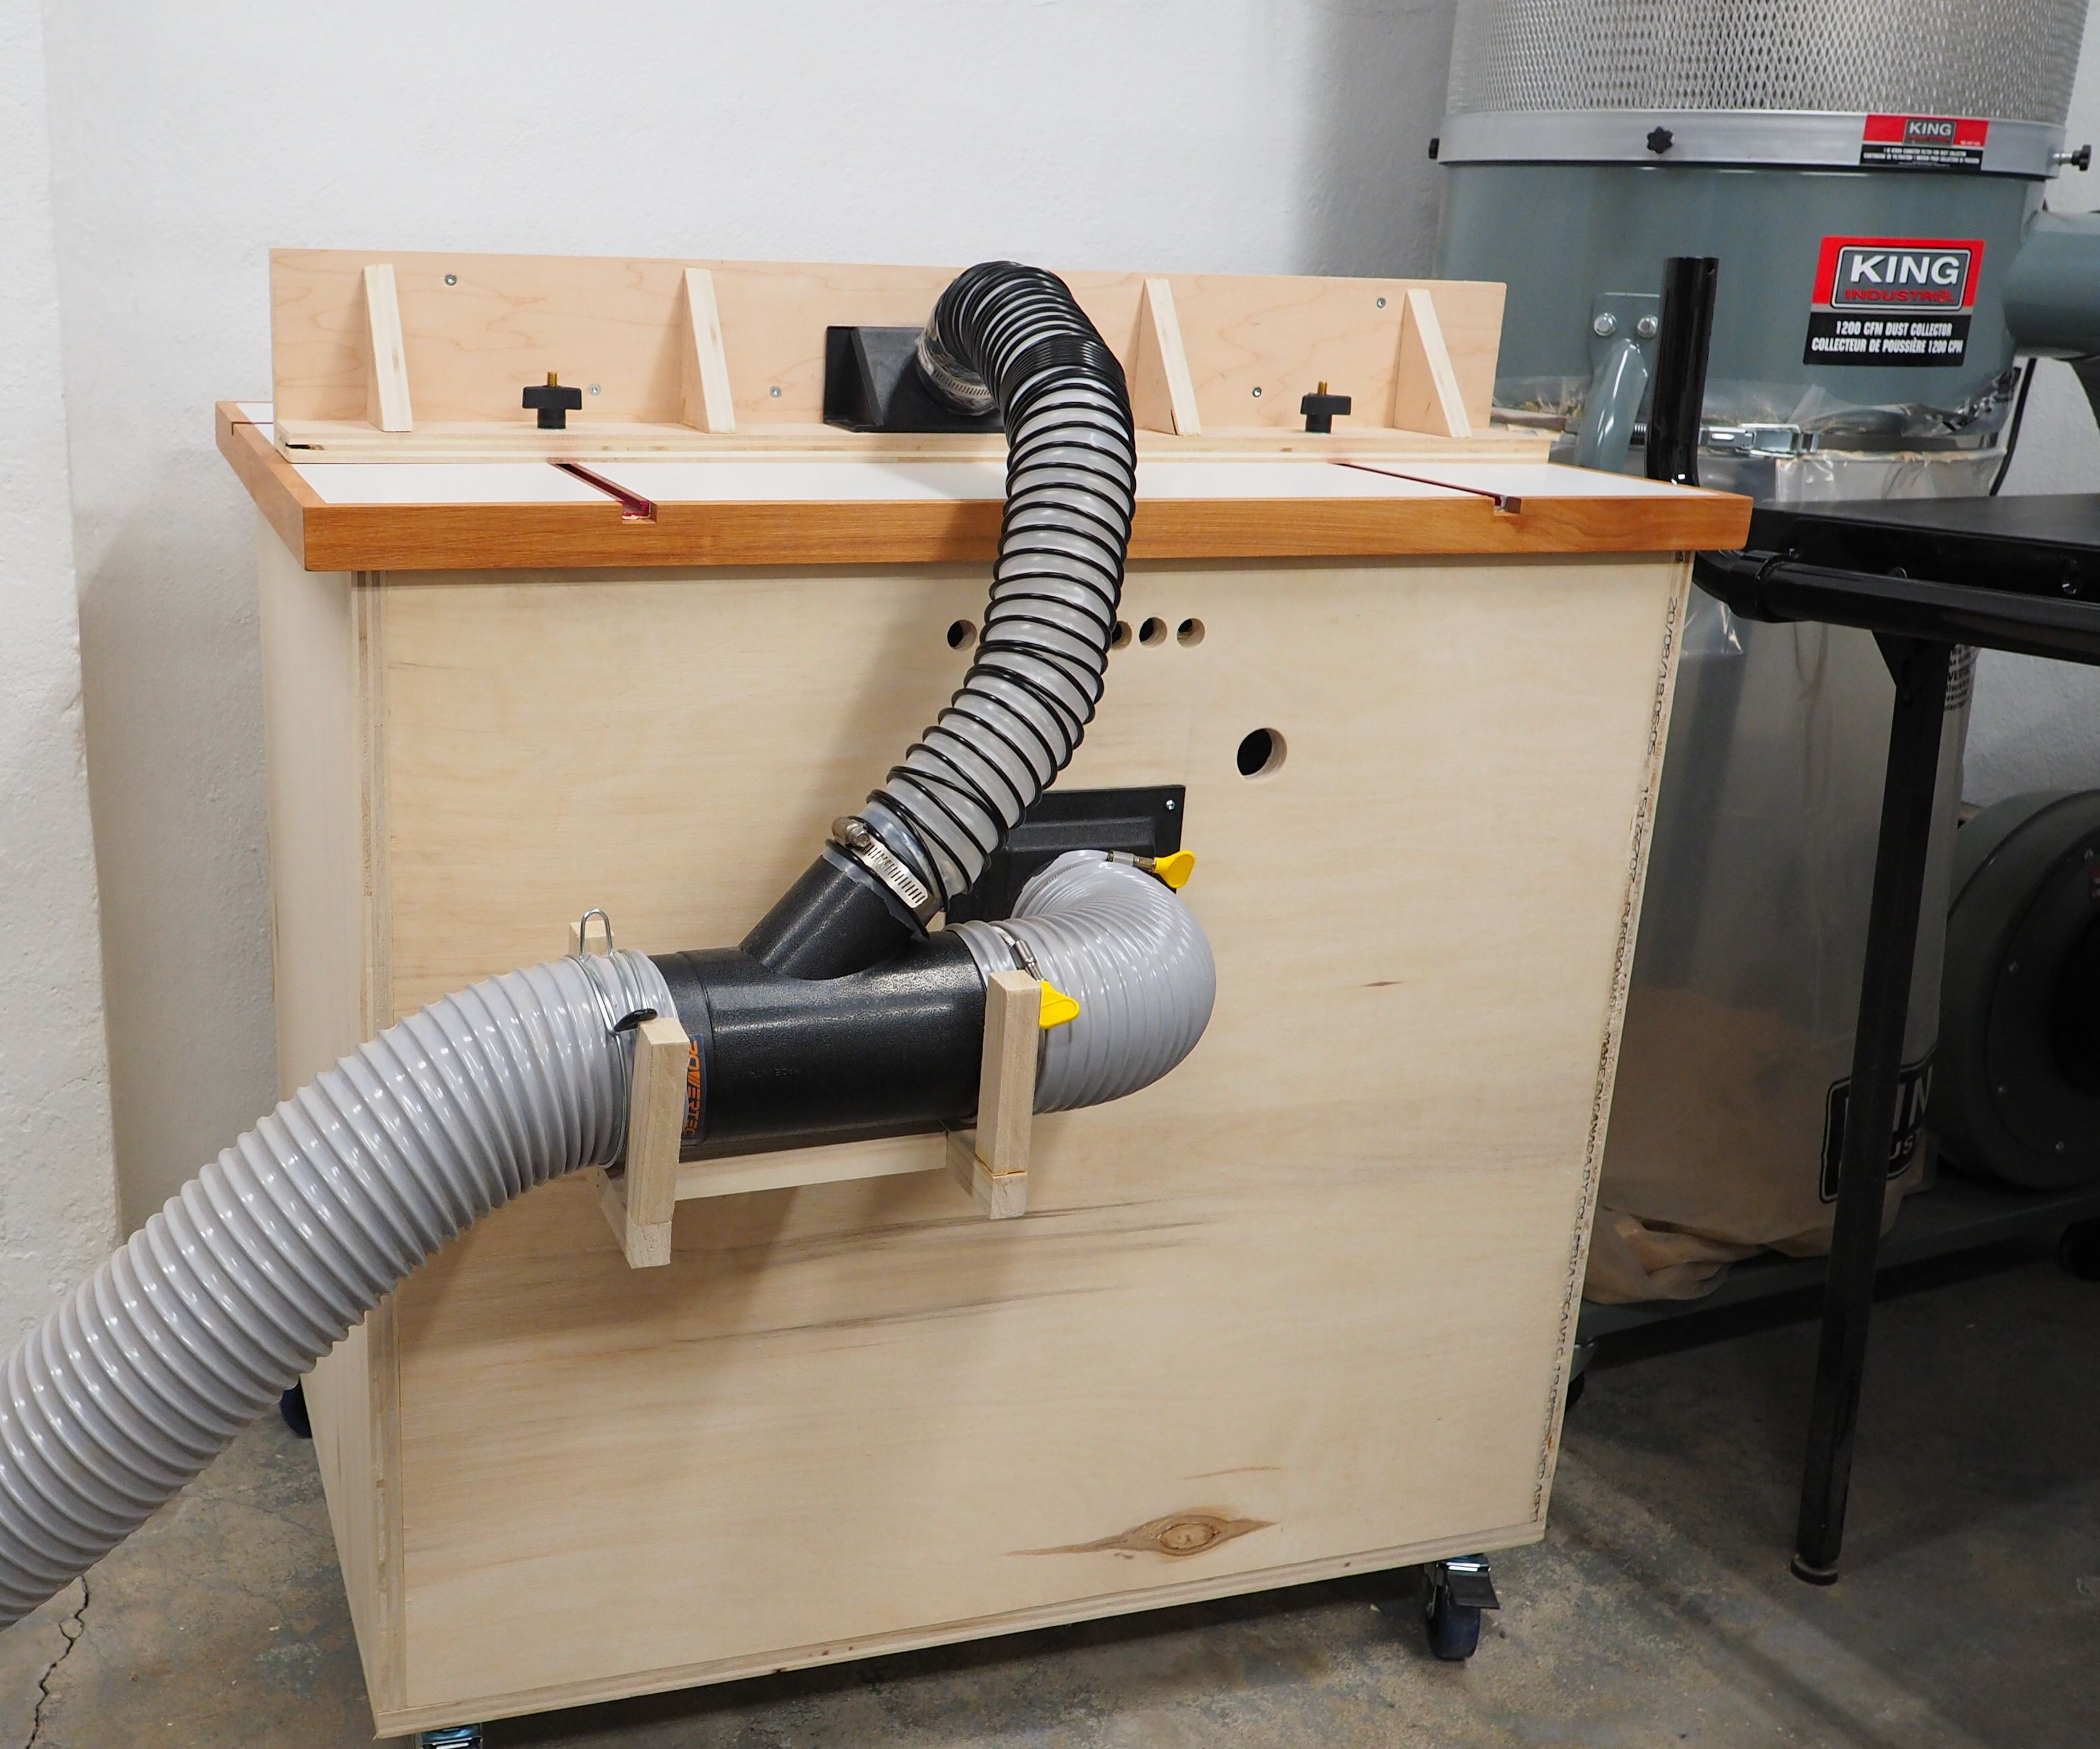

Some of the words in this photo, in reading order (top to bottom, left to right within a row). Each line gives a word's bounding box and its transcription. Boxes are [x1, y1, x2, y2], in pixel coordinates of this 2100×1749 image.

[1909, 121, 1952, 136] KING
[1850, 254, 1960, 285] KING
[1835, 321, 1861, 335] 1200
[1863, 321, 1883, 336] CFM
[1885, 322, 1909, 337] DUST
[1910, 323, 1953, 337] COLLECTOR
[1811, 337, 1867, 352] COLLECTEUR
[1869, 339, 1881, 353] DE
[1882, 336, 1927, 354] POUSSIÈRE
[1928, 339, 1947, 354] 1200
[1597, 1031, 1612, 1076] MADE
[1593, 1080, 1604, 1099] IN
[1584, 1103, 1601, 1166] CANADA
[1580, 1169, 1591, 1192] BY
